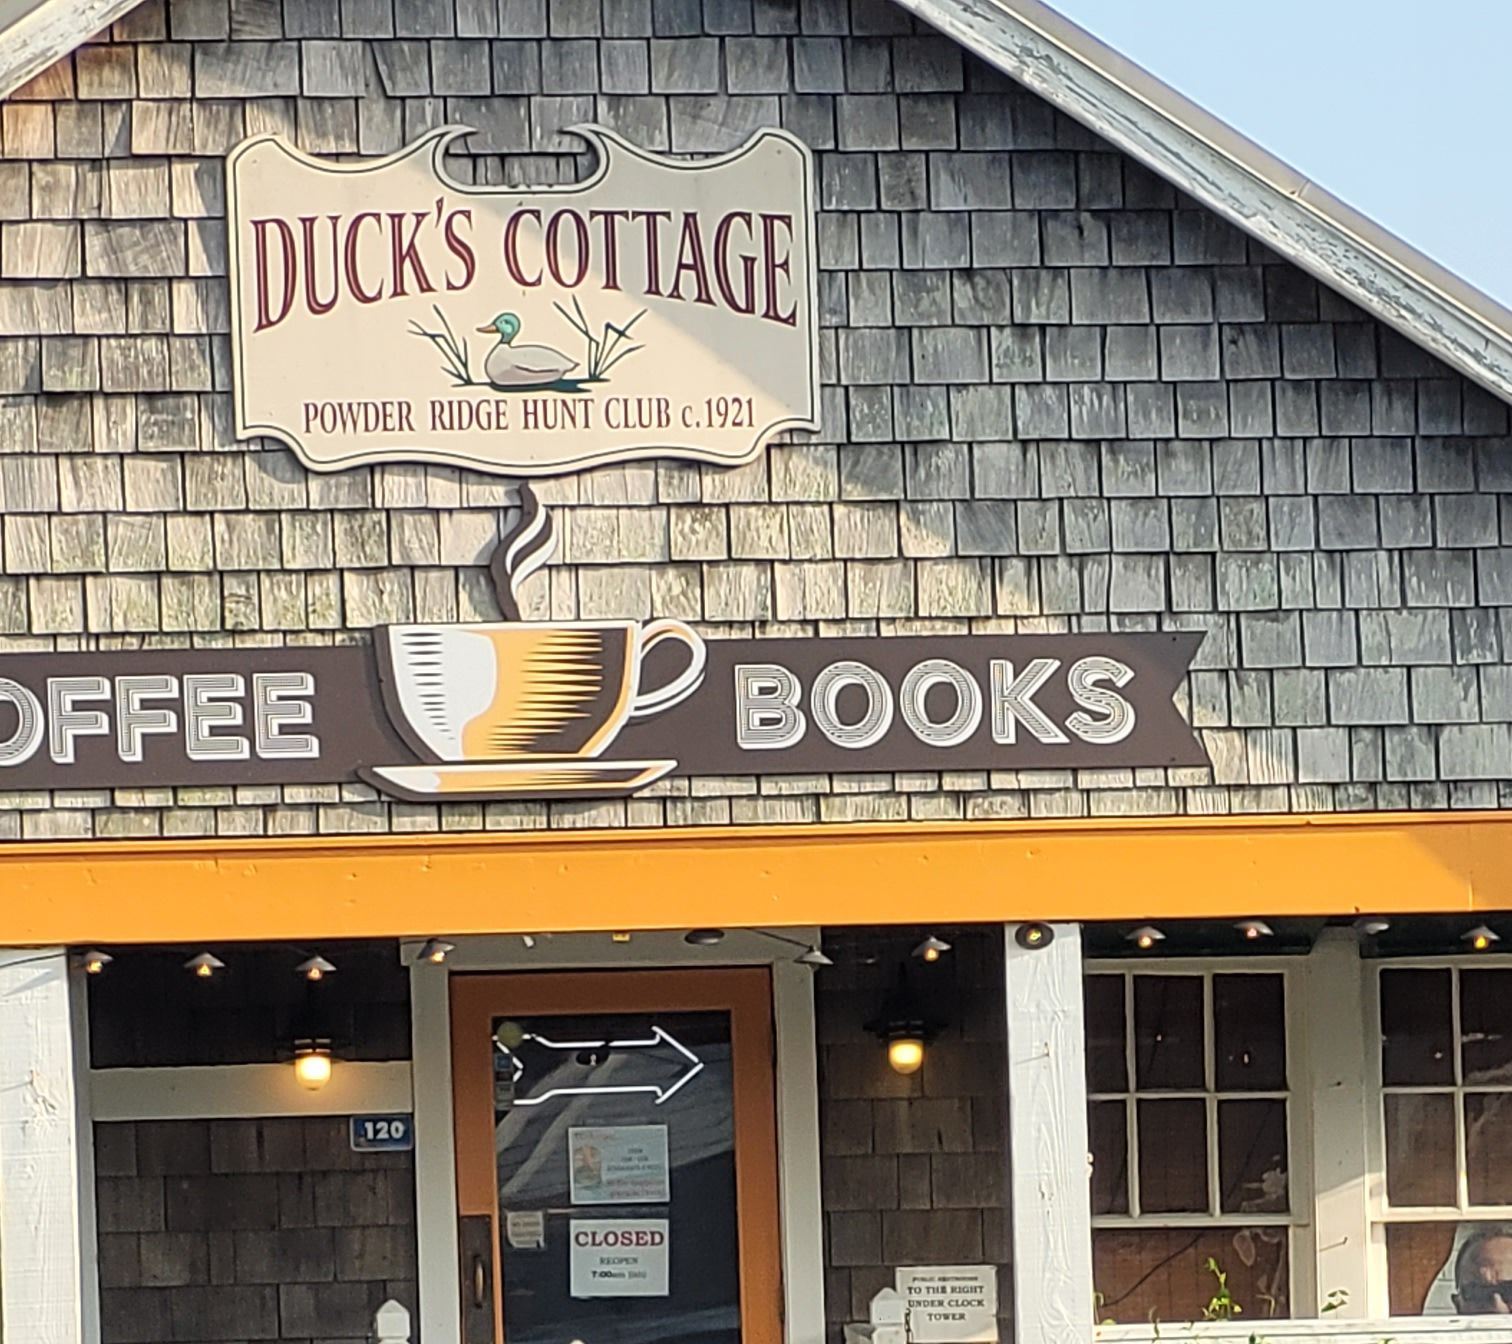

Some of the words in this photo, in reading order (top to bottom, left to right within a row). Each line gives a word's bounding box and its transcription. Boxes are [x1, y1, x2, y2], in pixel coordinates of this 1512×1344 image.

[251, 197, 475, 334] DUCK'S
[503, 207, 797, 327] COTTAGE
[303, 400, 415, 434] POWDER
[430, 399, 509, 432] RIDGE
[522, 398, 595, 431] HUNT
[604, 397, 671, 429] CLUB
[734, 655, 1137, 750] BOOKS
[364, 1120, 405, 1139] 120
[574, 1230, 665, 1247] CLOSED
[907, 1286, 922, 1295] TO
[925, 1286, 947, 1294] THE
[950, 1285, 984, 1294] RIGHT
[907, 1299, 945, 1308] UNDER
[947, 1299, 985, 1308] CLOCK
[927, 1313, 966, 1322] TOWER
